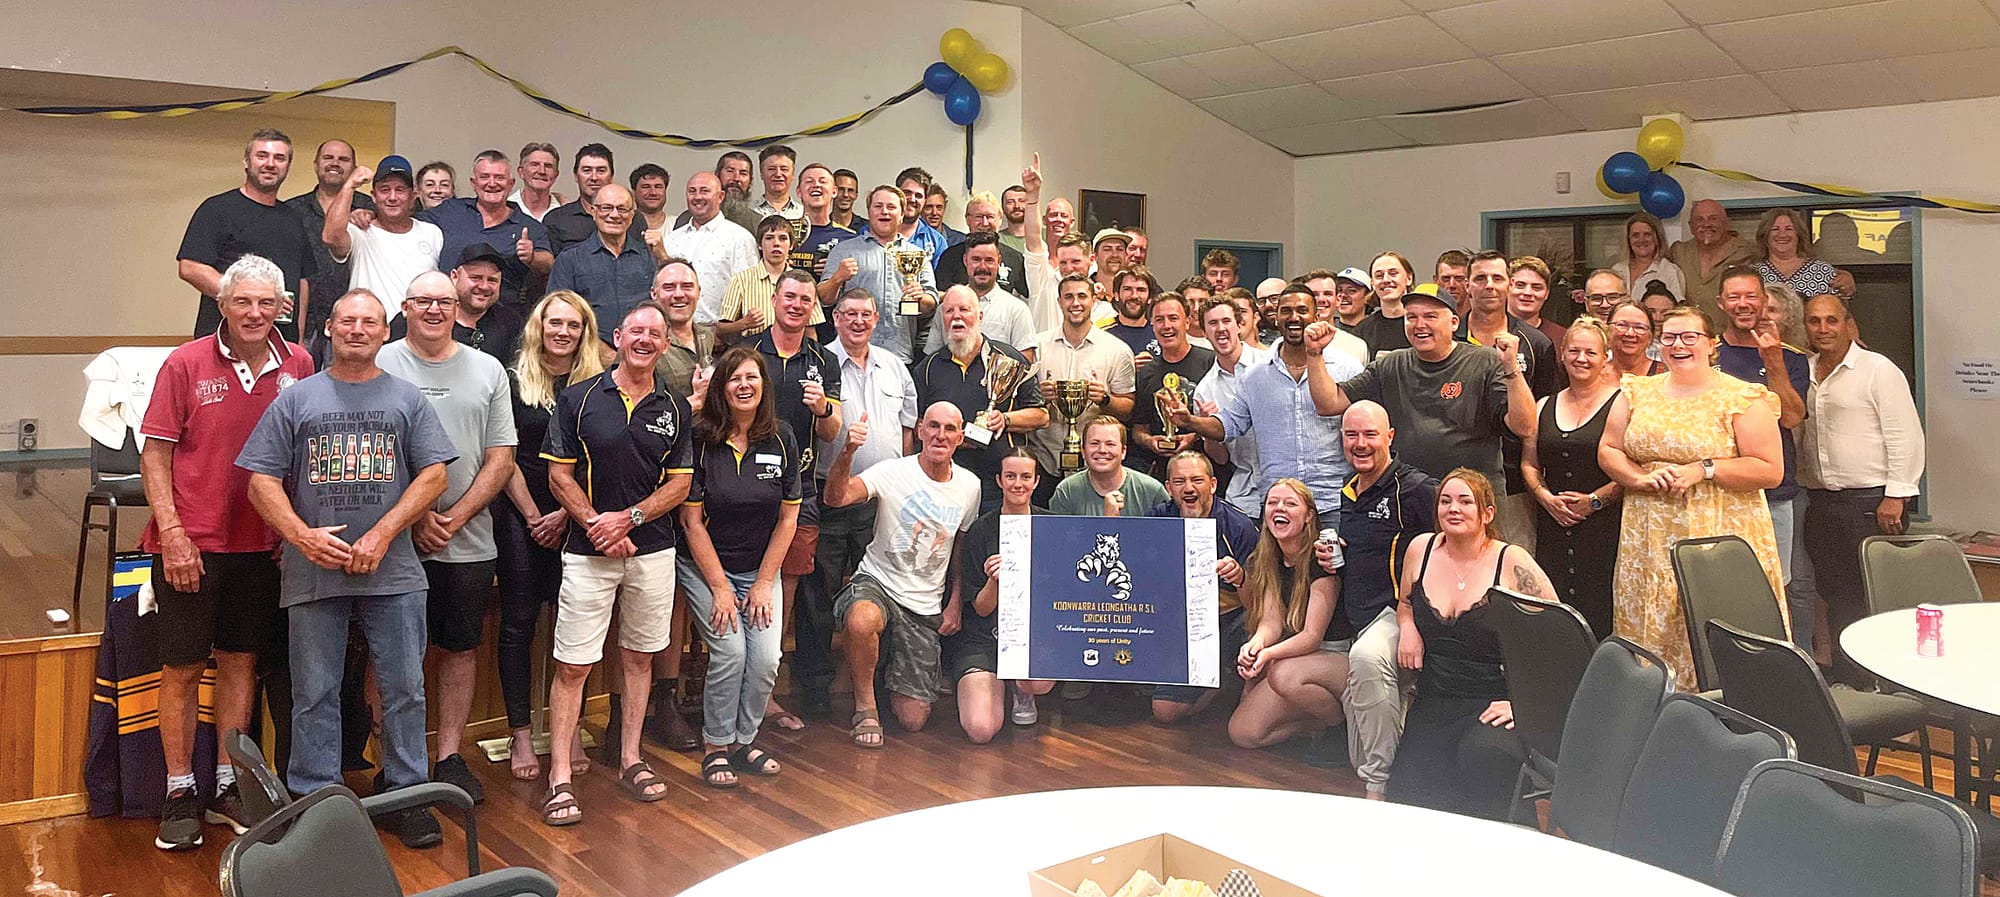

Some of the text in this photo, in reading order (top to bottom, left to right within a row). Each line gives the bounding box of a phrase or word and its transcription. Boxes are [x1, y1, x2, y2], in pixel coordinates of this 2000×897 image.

[322, 410, 386, 422] BEER MAY NOT
[332, 421, 357, 433] YOUR
[328, 484, 367, 494] NEITHER
[369, 483, 387, 493] WILL
[347, 495, 360, 506] OR
[362, 494, 384, 505] MILK
[1053, 601, 1096, 611] KOONWARRA
[1097, 602, 1137, 613] LEONGATHA
[1083, 613, 1132, 624] CRICKET CLUB
